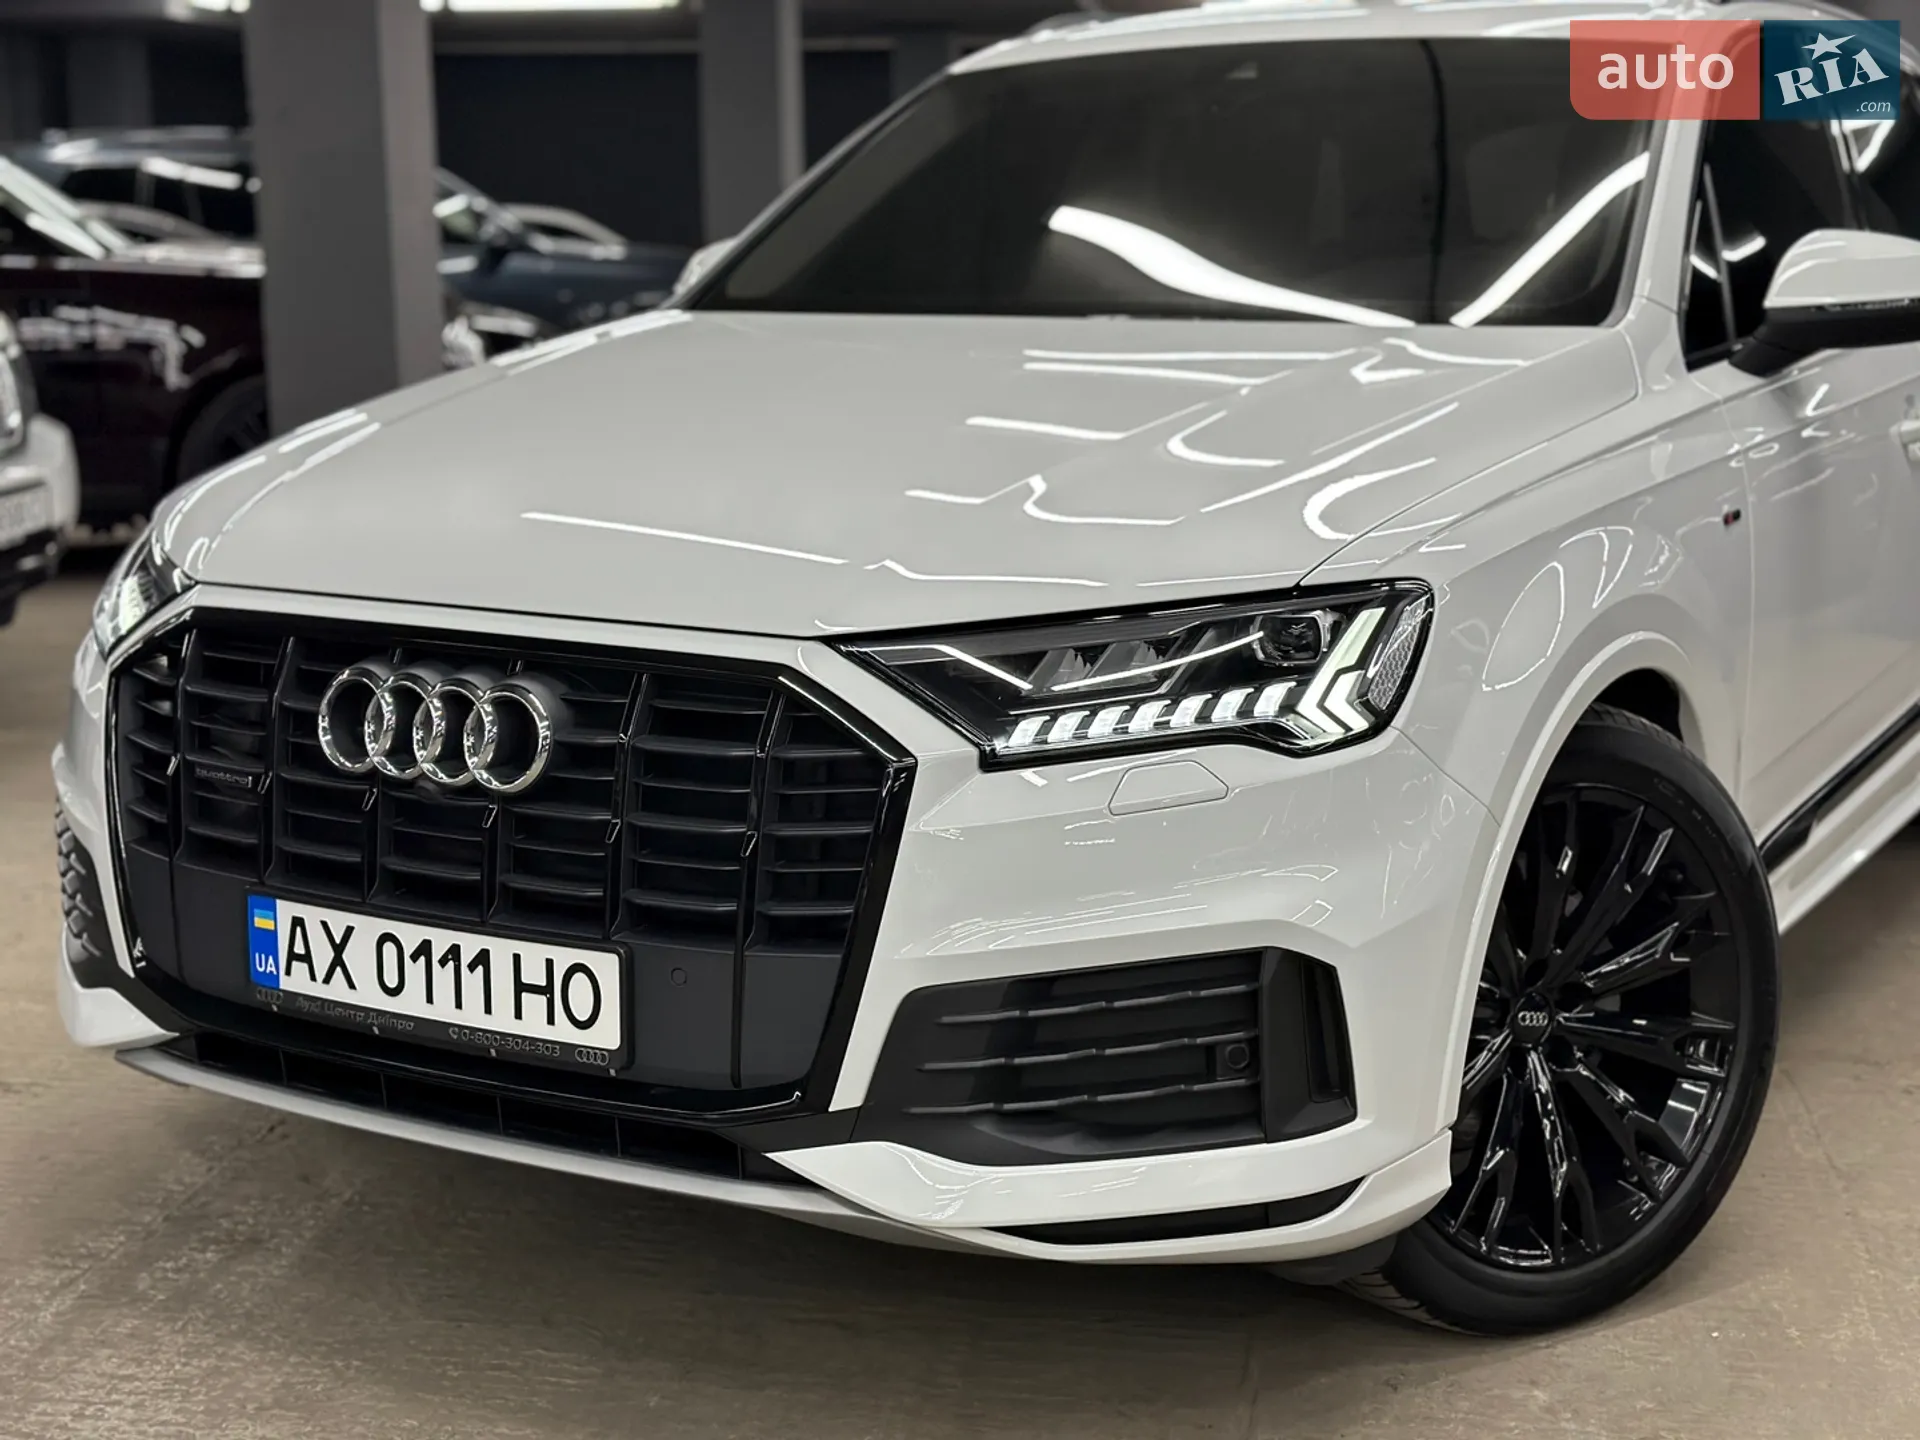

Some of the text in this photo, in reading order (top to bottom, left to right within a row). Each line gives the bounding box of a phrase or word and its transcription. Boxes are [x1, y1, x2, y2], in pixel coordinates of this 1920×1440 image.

[255, 953, 278, 976] UA
[284, 915, 602, 1031] AX 0111 HO
[324, 1002, 366, 1022] Центр
[367, 1012, 415, 1031] Дніпро
[461, 1029, 561, 1058] 0-800-304-303
